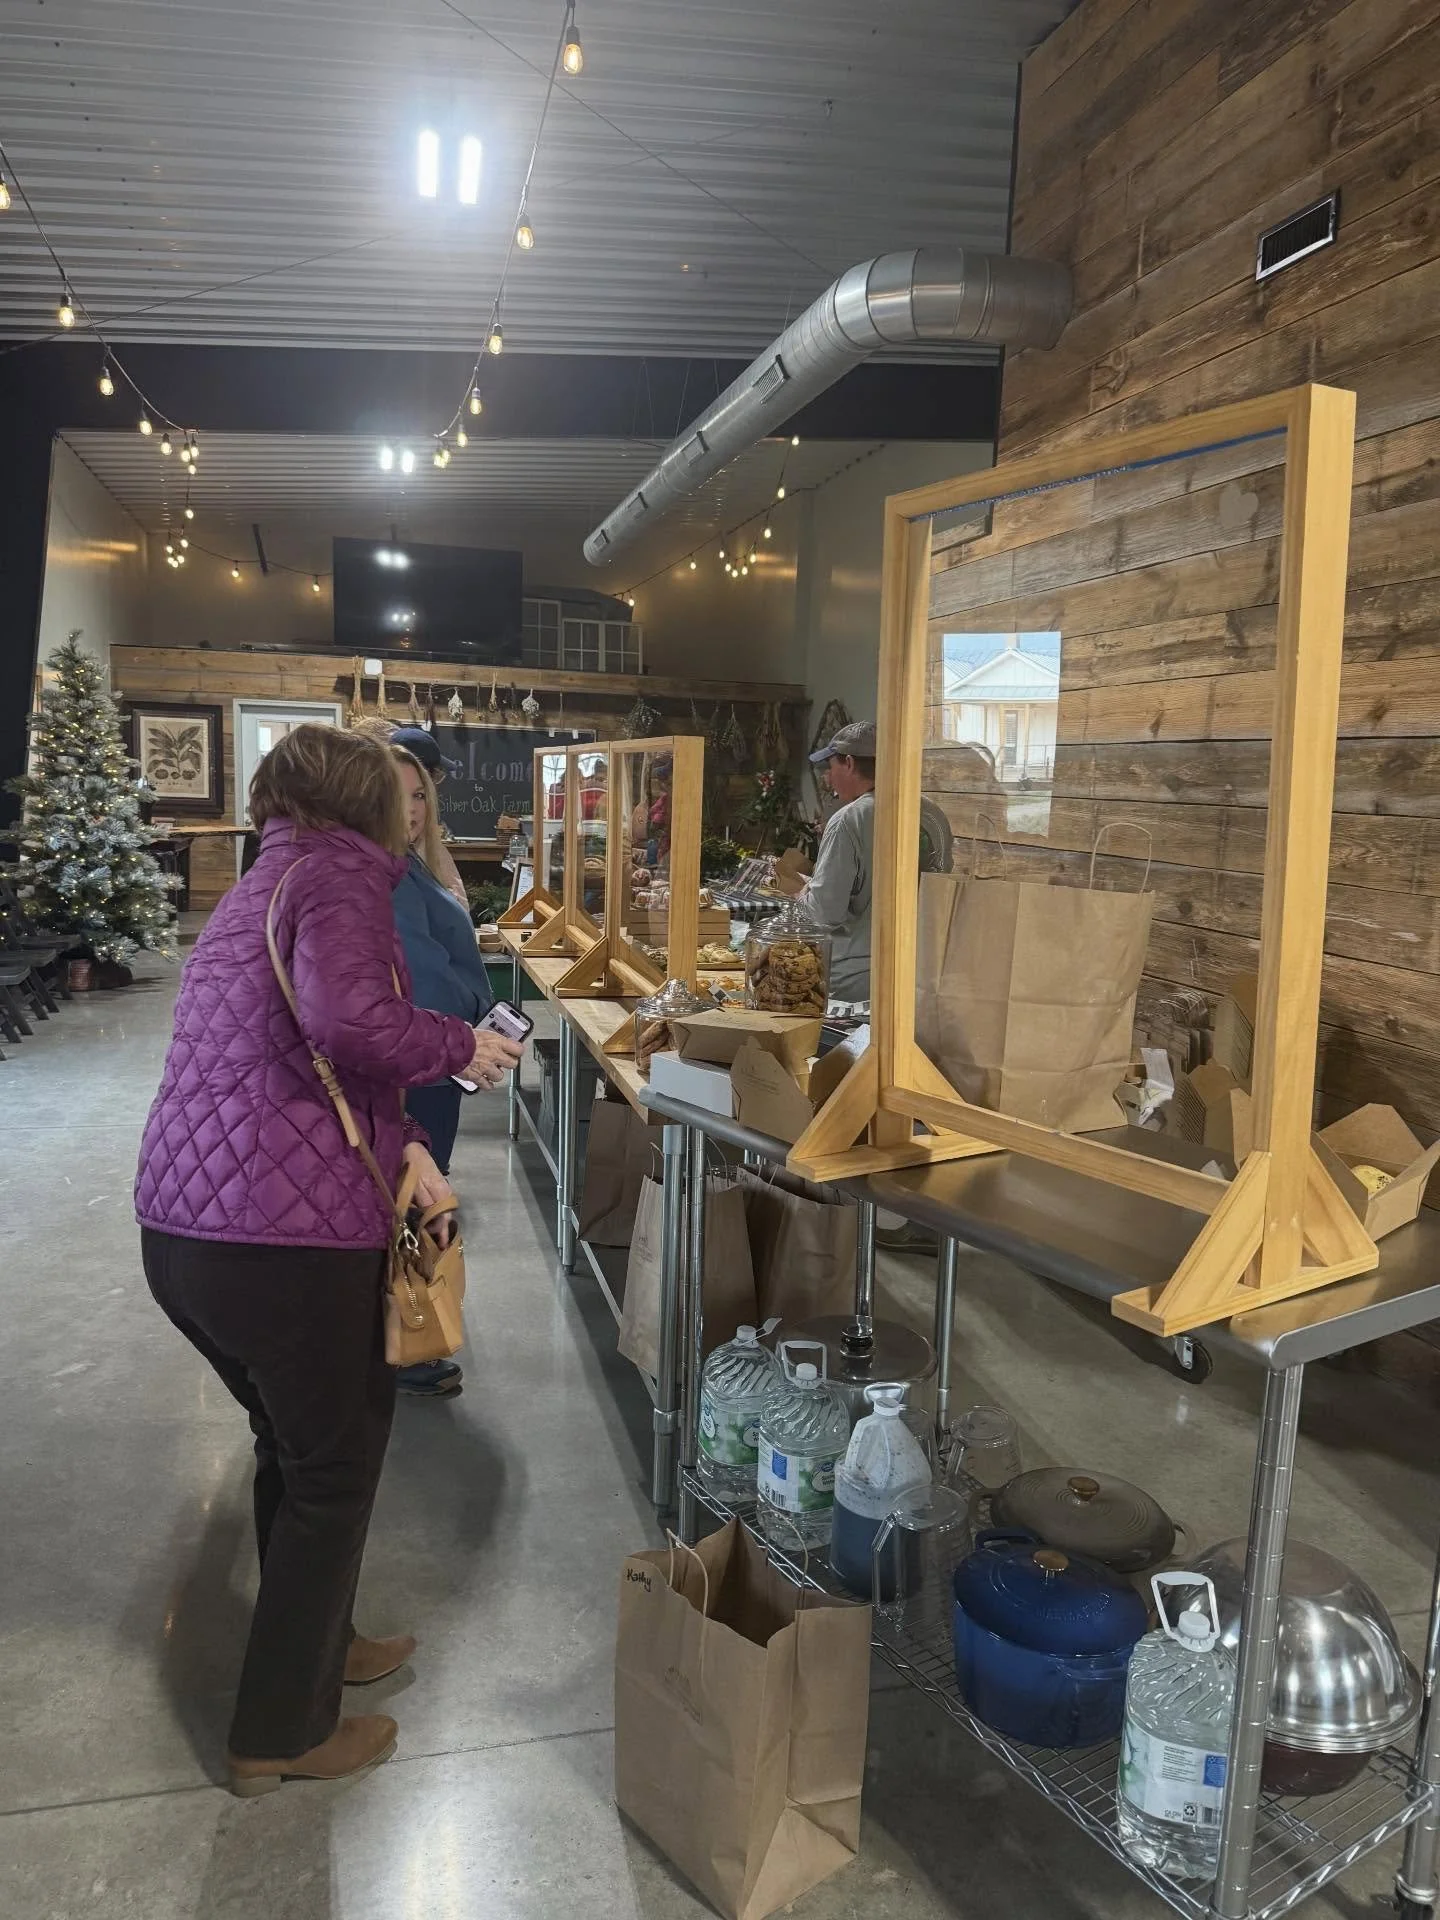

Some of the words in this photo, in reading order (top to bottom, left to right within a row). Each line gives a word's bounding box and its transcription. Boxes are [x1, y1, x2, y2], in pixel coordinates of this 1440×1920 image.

[474, 783, 484, 792] to
[471, 796, 498, 813] Oak
[627, 1568, 652, 1593] Kathy
